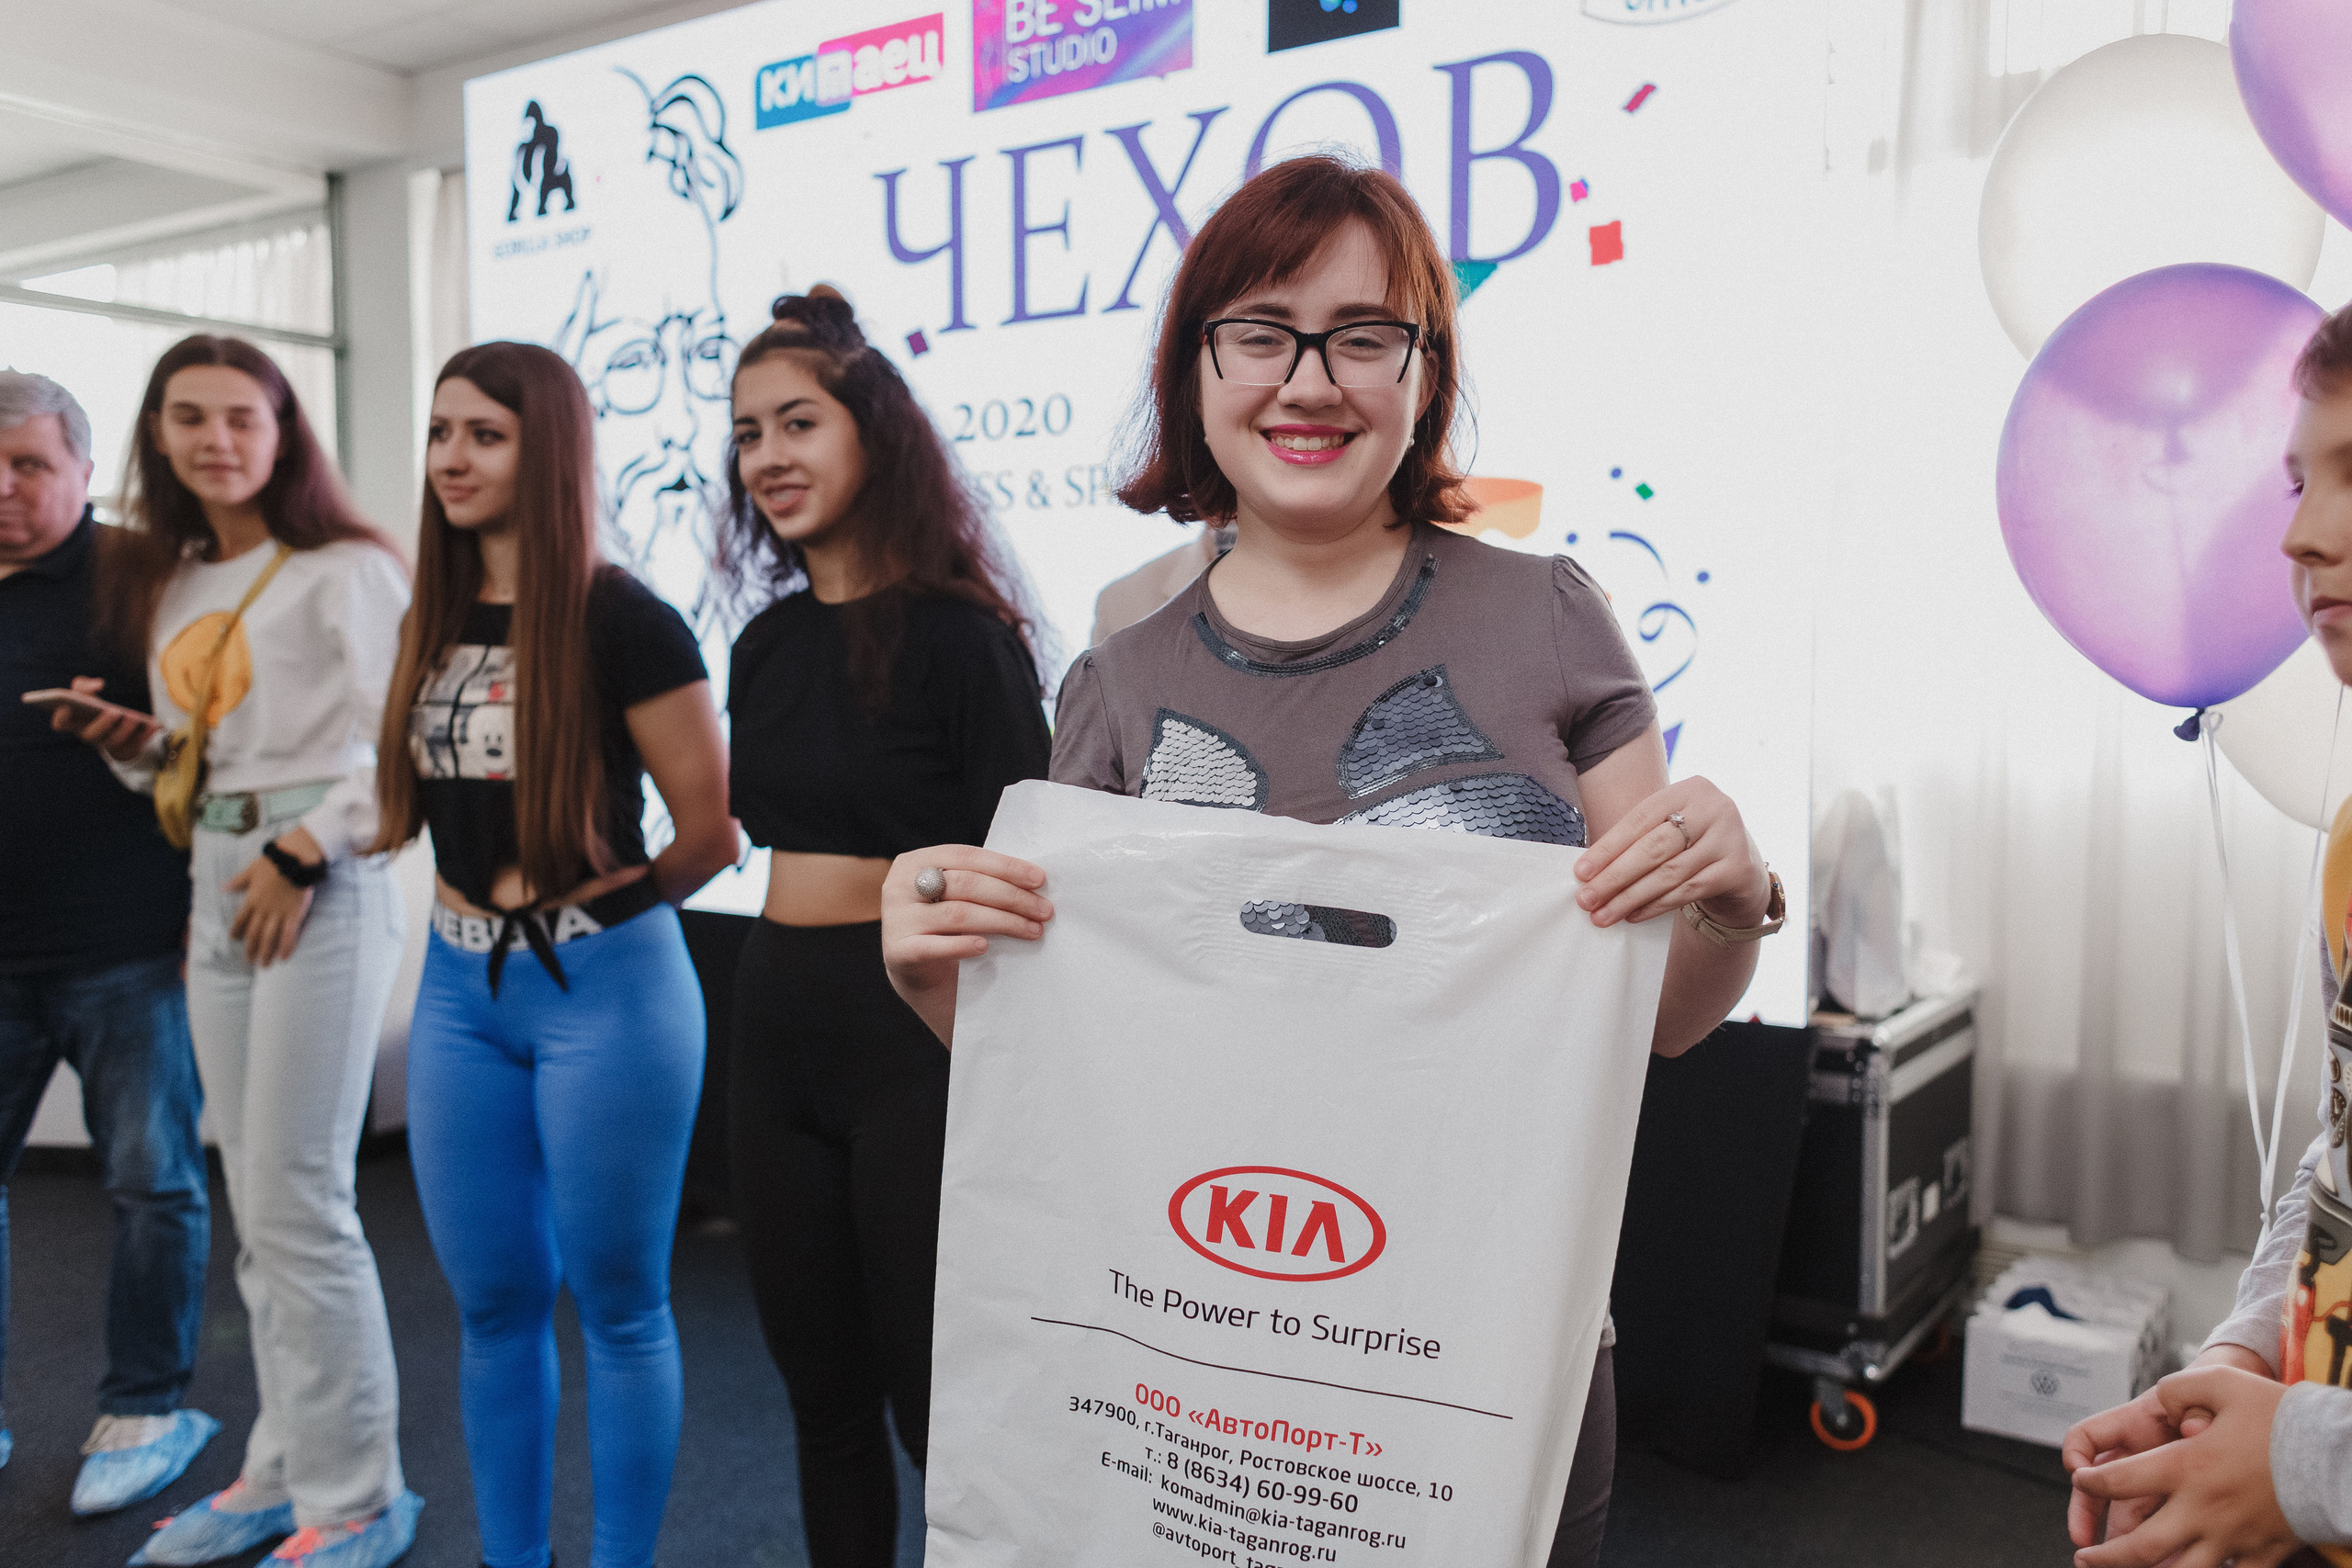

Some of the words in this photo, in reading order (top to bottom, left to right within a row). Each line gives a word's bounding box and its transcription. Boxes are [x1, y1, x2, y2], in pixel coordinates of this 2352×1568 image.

[1007, 26, 1118, 84] STUDIO
[953, 392, 1073, 443] 2020
[1205, 1184, 1346, 1264] KIA
[1109, 1268, 1155, 1308] The
[1163, 1289, 1261, 1329] Power
[1270, 1309, 1301, 1336] to
[1311, 1314, 1442, 1359] Surprise
[1069, 1395, 1139, 1430] 347900,
[1145, 1420, 1234, 1465] г.Таганрог,
[1240, 1449, 1351, 1483] Ростовское
[1357, 1472, 1421, 1498] шоссе,
[1429, 1482, 1453, 1502] 10
[1188, 1408, 1383, 1457] «АвтоПорт-Т»
[1102, 1451, 1153, 1483] E-mail:
[1160, 1474, 1406, 1549] komadmin@kia-taganrog.ru
[1167, 1451, 1179, 1470] 8
[1184, 1459, 1250, 1499] (8634)
[1257, 1480, 1359, 1513] 60-99-60
[1152, 1498, 1337, 1562] www.kia-taganrog.ru
